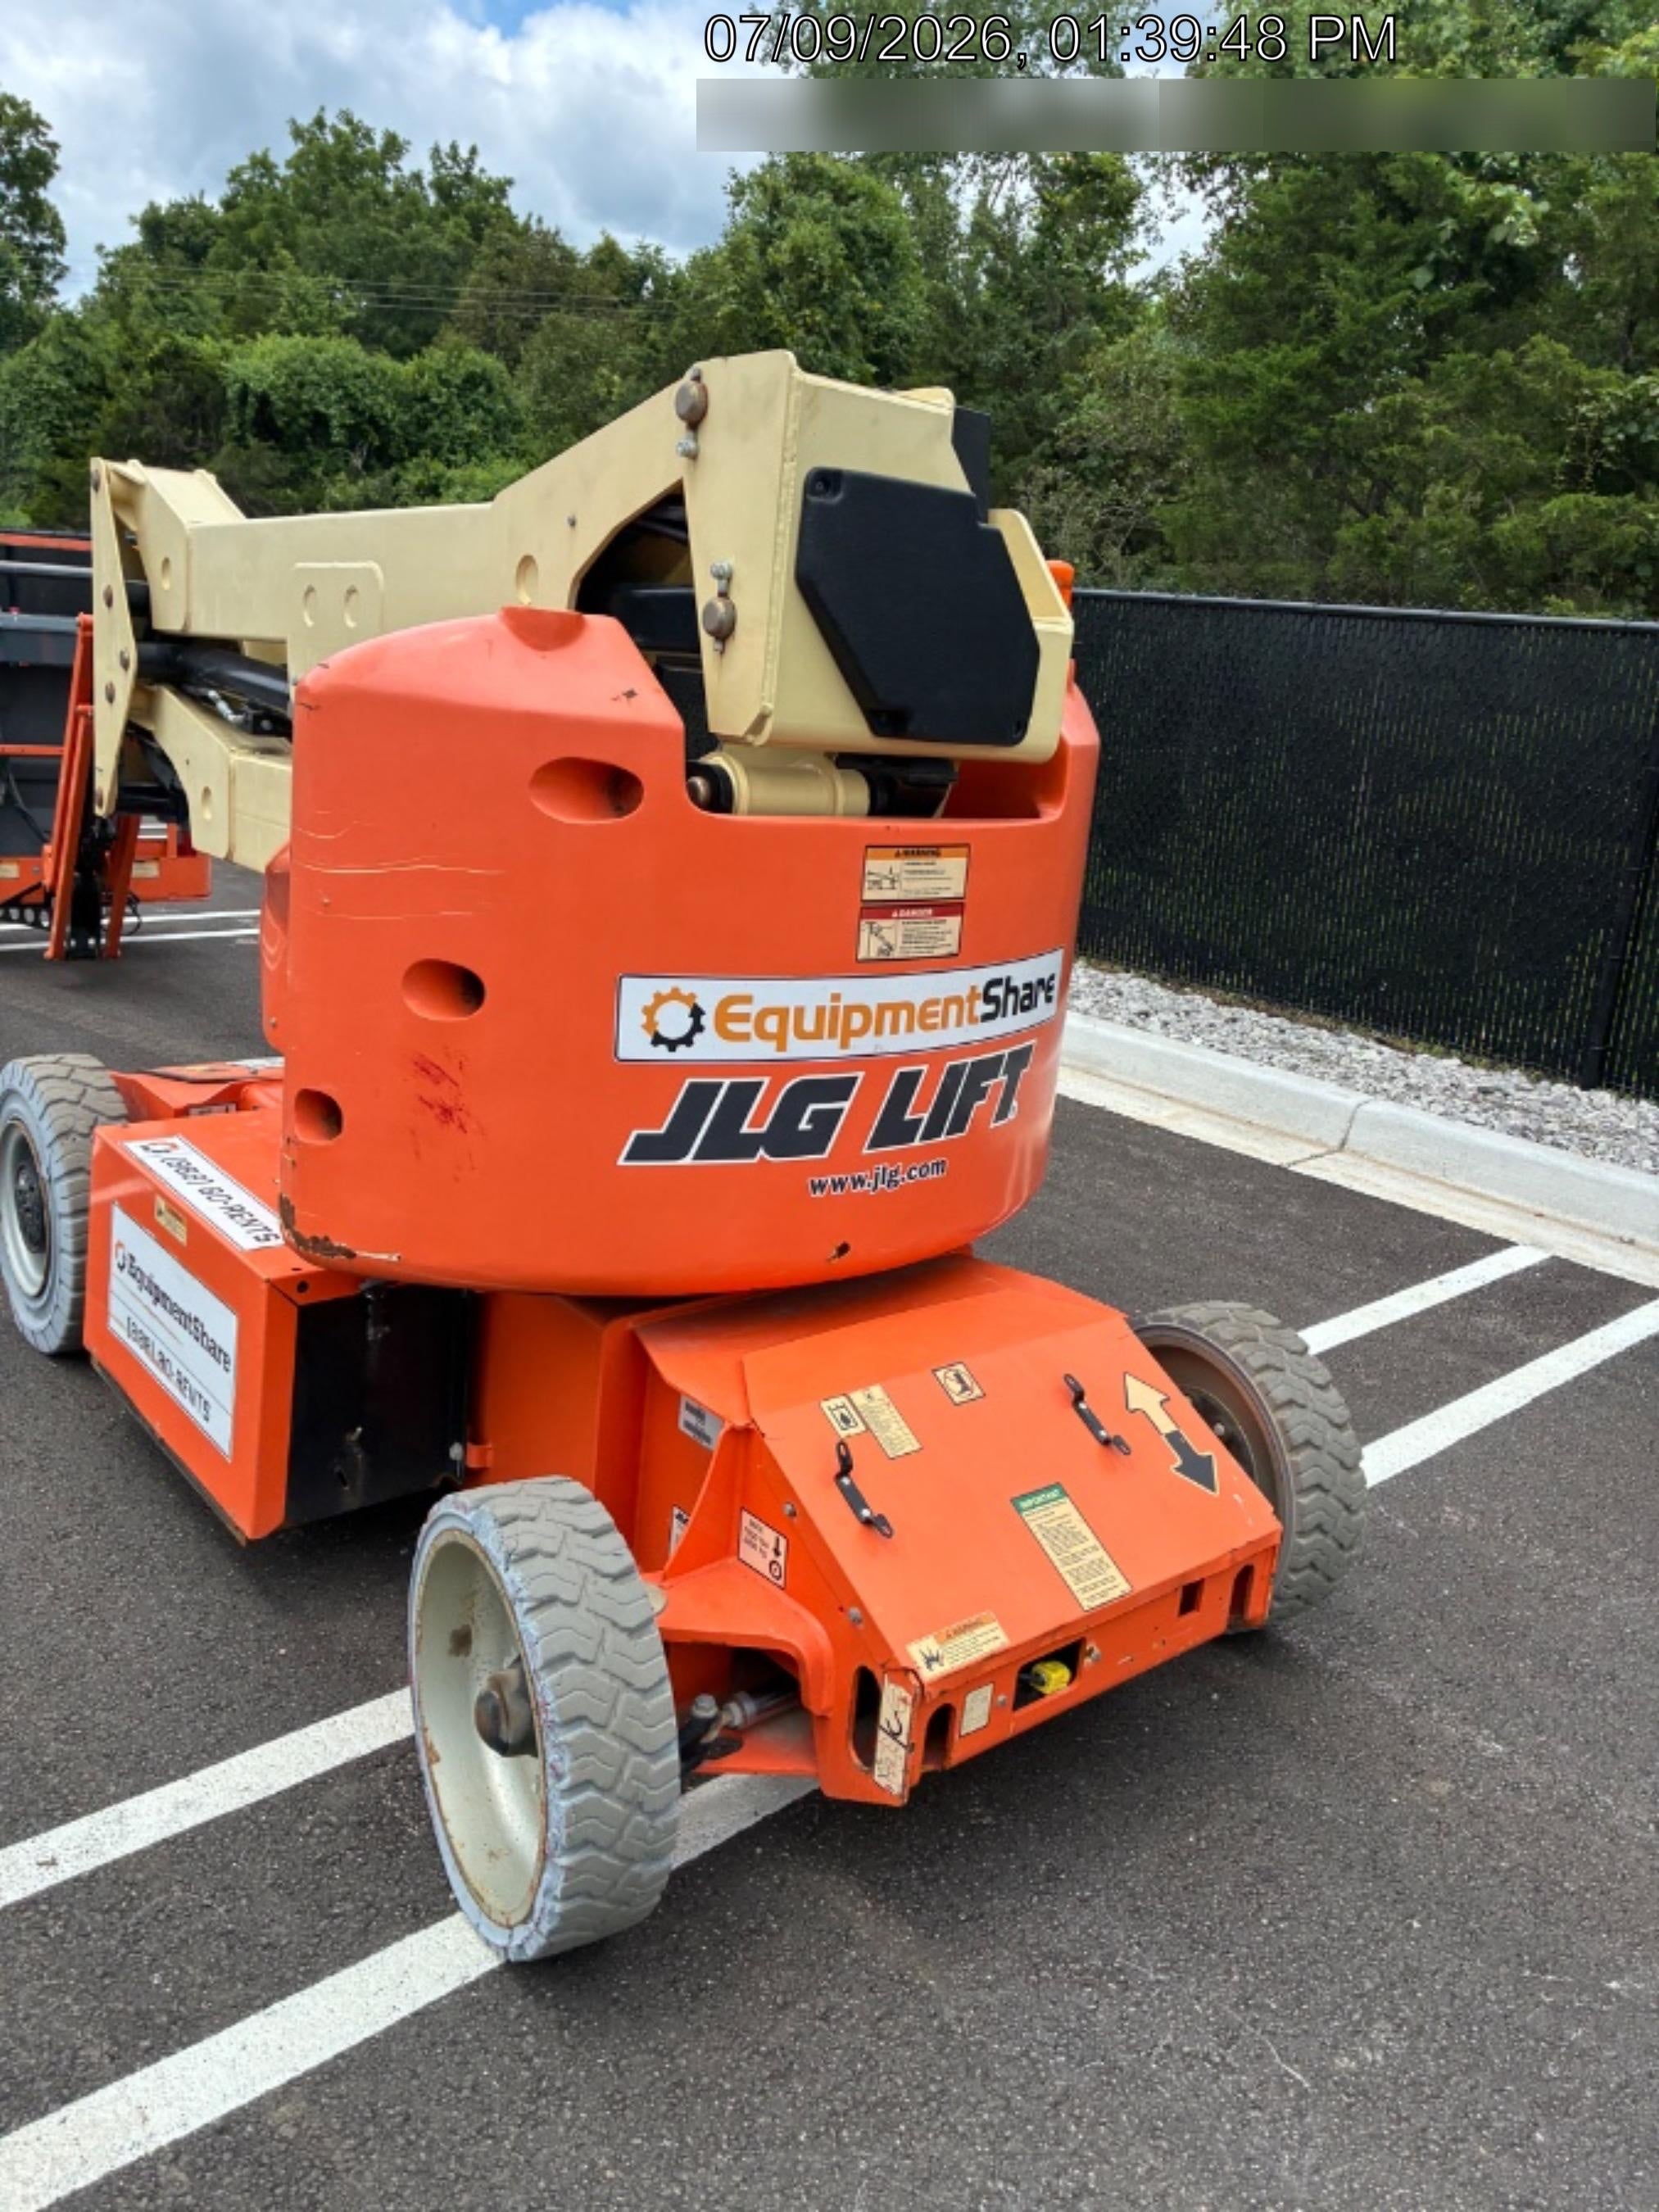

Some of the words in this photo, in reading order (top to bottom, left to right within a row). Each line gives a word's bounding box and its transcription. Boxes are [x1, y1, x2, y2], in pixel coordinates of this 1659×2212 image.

[713, 972, 1056, 1052] EquipmentShare
[618, 1072, 863, 1164] JLG
[863, 1040, 1036, 1154] LIFT
[809, 1158, 947, 1196] www.jlg.com
[126, 1251, 231, 1373] EquipmentShare
